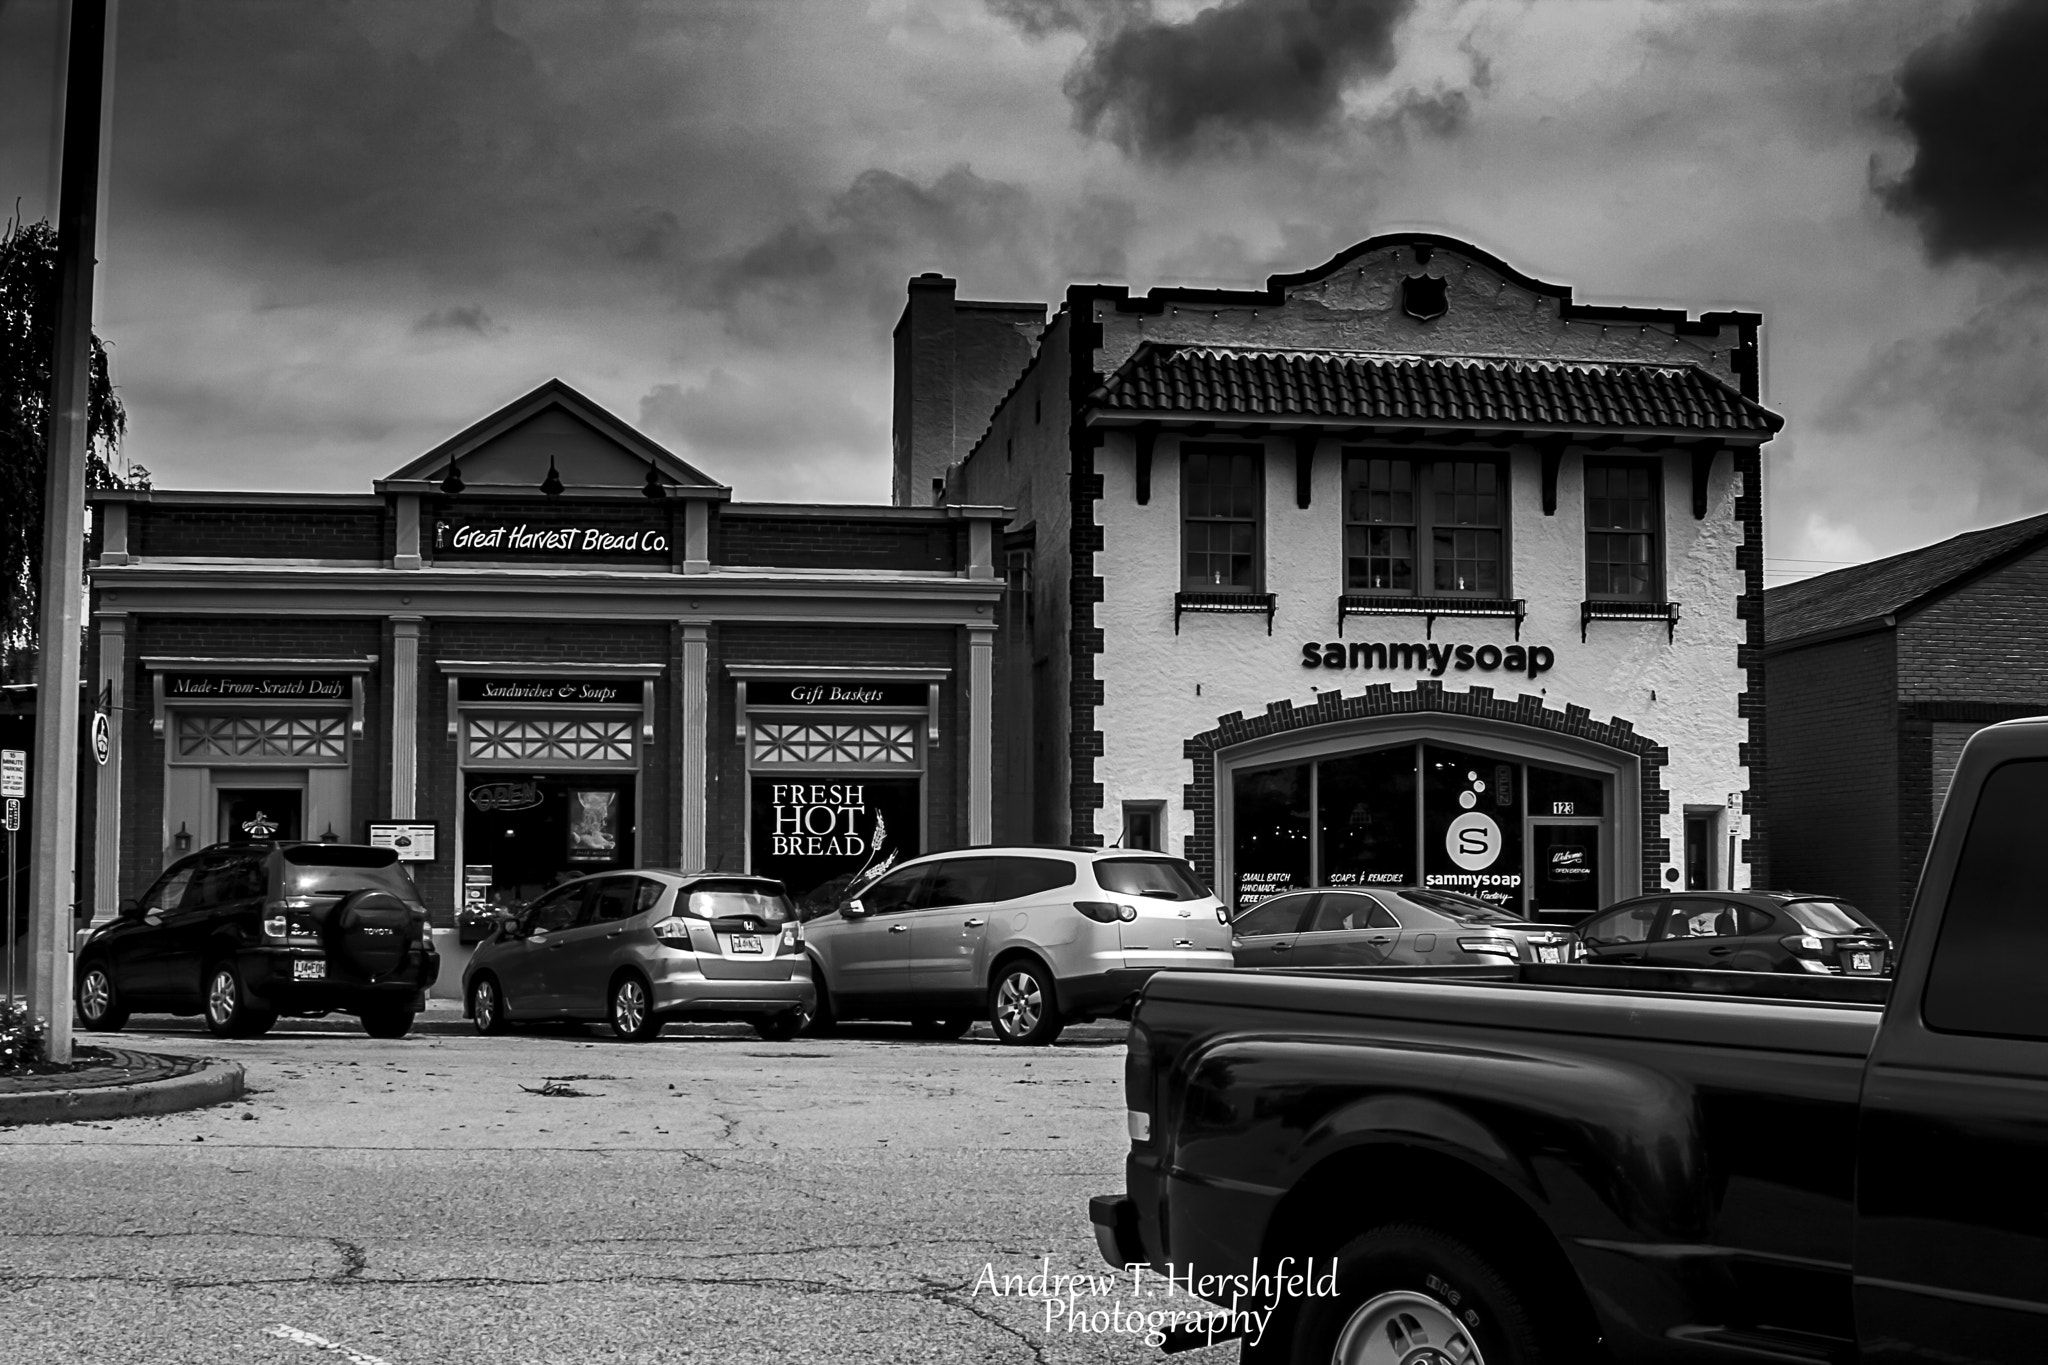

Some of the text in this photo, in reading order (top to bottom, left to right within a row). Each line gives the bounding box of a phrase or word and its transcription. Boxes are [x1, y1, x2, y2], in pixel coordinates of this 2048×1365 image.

[453, 524, 669, 551] Great Harvest Bread Co.
[1301, 642, 1555, 679] sammysoap
[174, 679, 344, 698] Made-From-Scratch Daily
[482, 683, 617, 702] Sandwiches & Soups
[791, 685, 883, 704] Gift Baskets
[476, 781, 538, 811] OPEN
[772, 784, 865, 805] FRESH
[1554, 803, 1573, 814] 123
[772, 805, 865, 836] HOT
[772, 836, 865, 856] BREAD
[1458, 828, 1488, 854] S
[1242, 873, 1291, 882] SMALL BATCH
[1330, 873, 1356, 882] SOAPS
[1367, 873, 1403, 882] REMEDIES
[1426, 874, 1521, 888] sammysoap
[1240, 894, 1259, 902] FREE
